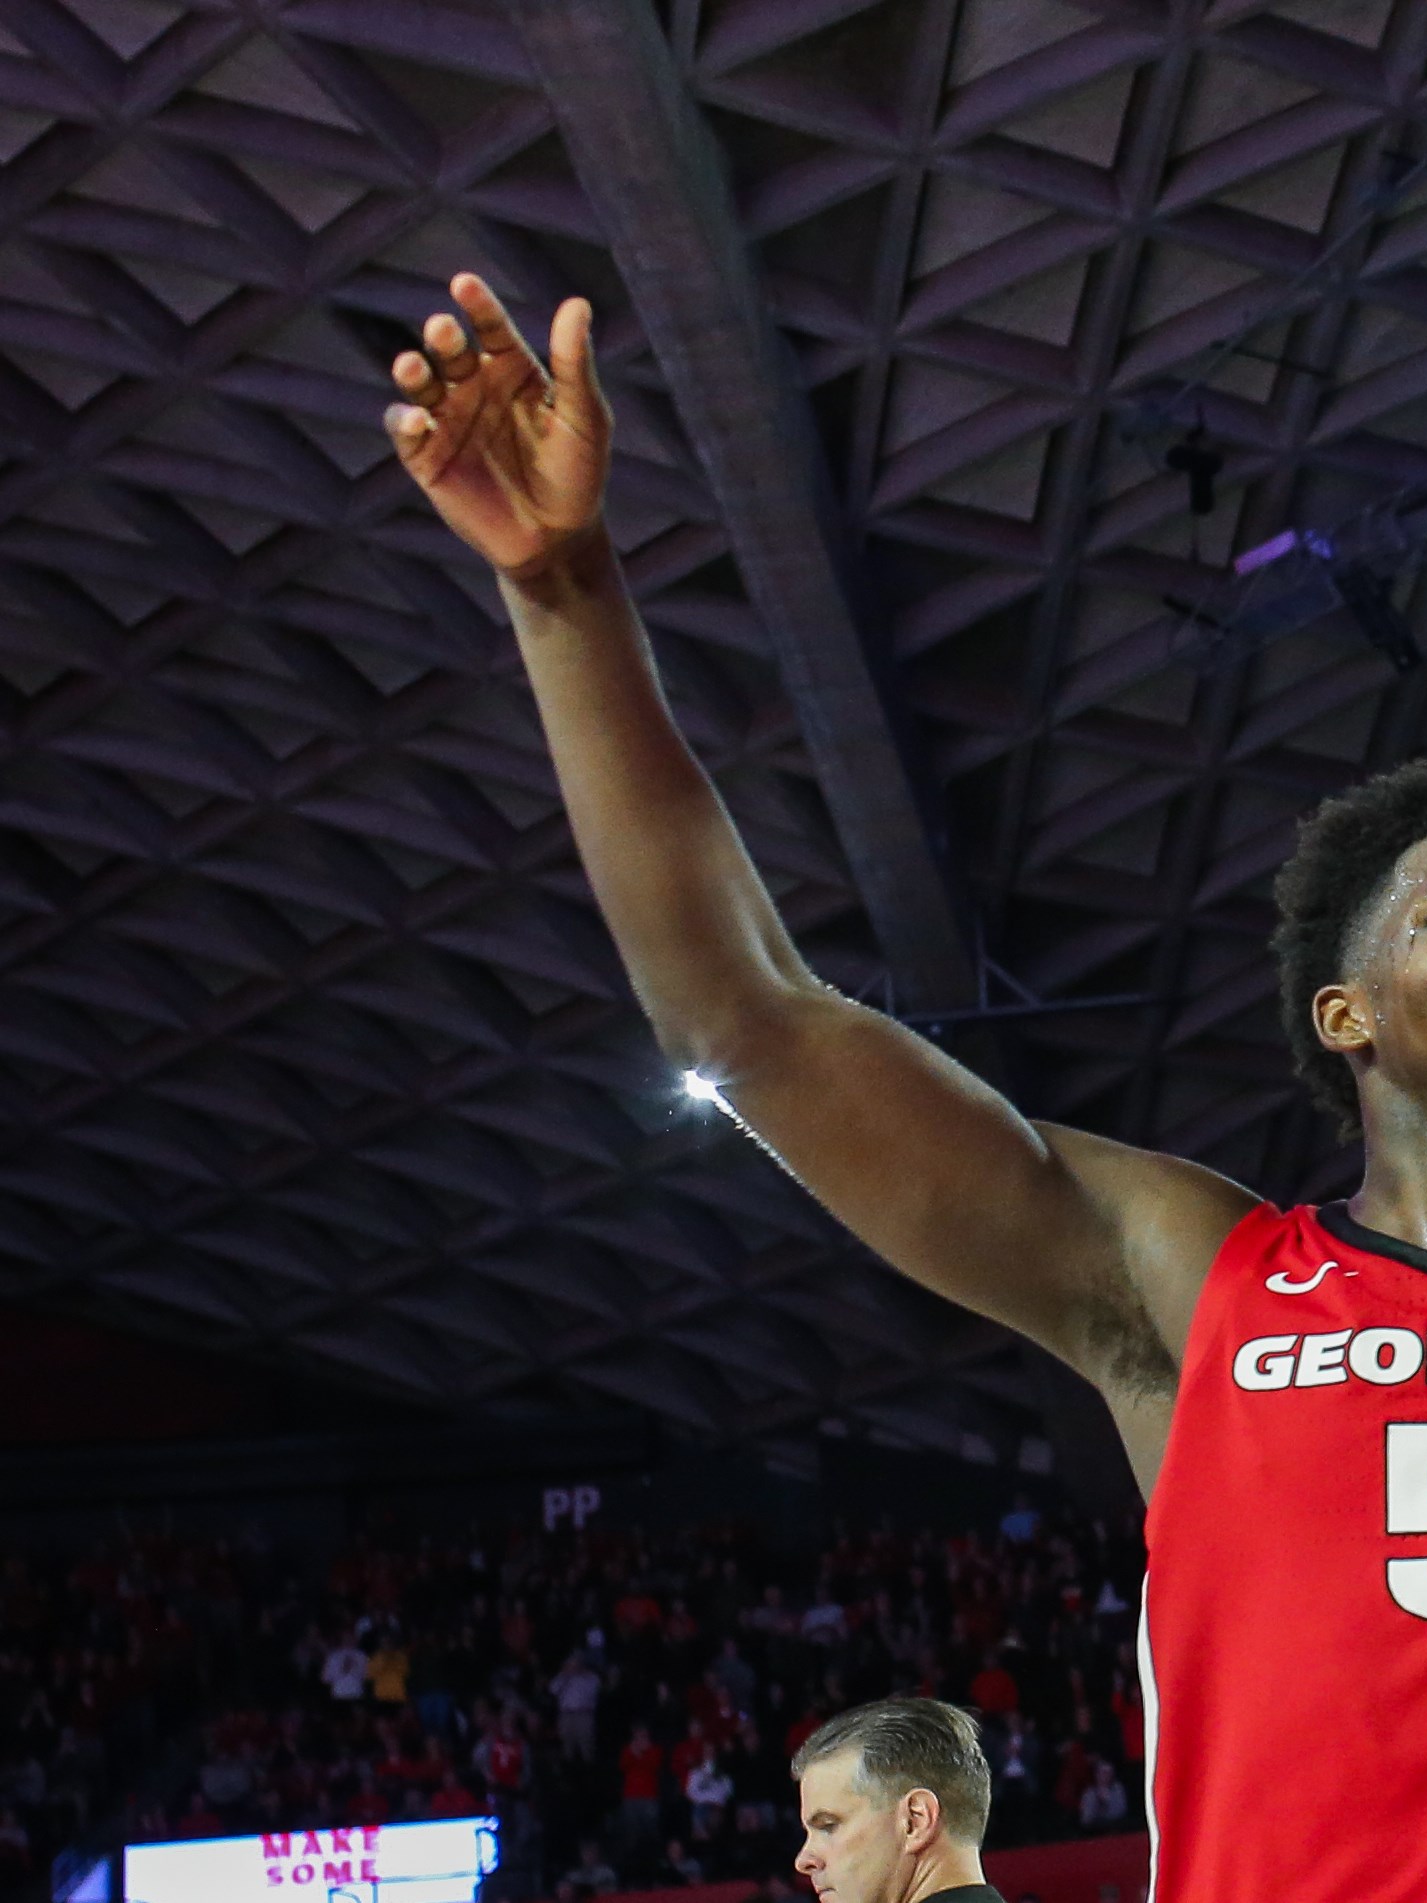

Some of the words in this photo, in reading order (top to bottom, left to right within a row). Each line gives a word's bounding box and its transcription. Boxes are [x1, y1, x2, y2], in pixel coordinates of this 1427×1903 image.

[542, 1484, 600, 1533] PP
[262, 1826, 379, 1856] MAKE
[267, 1859, 380, 1885] SOME
